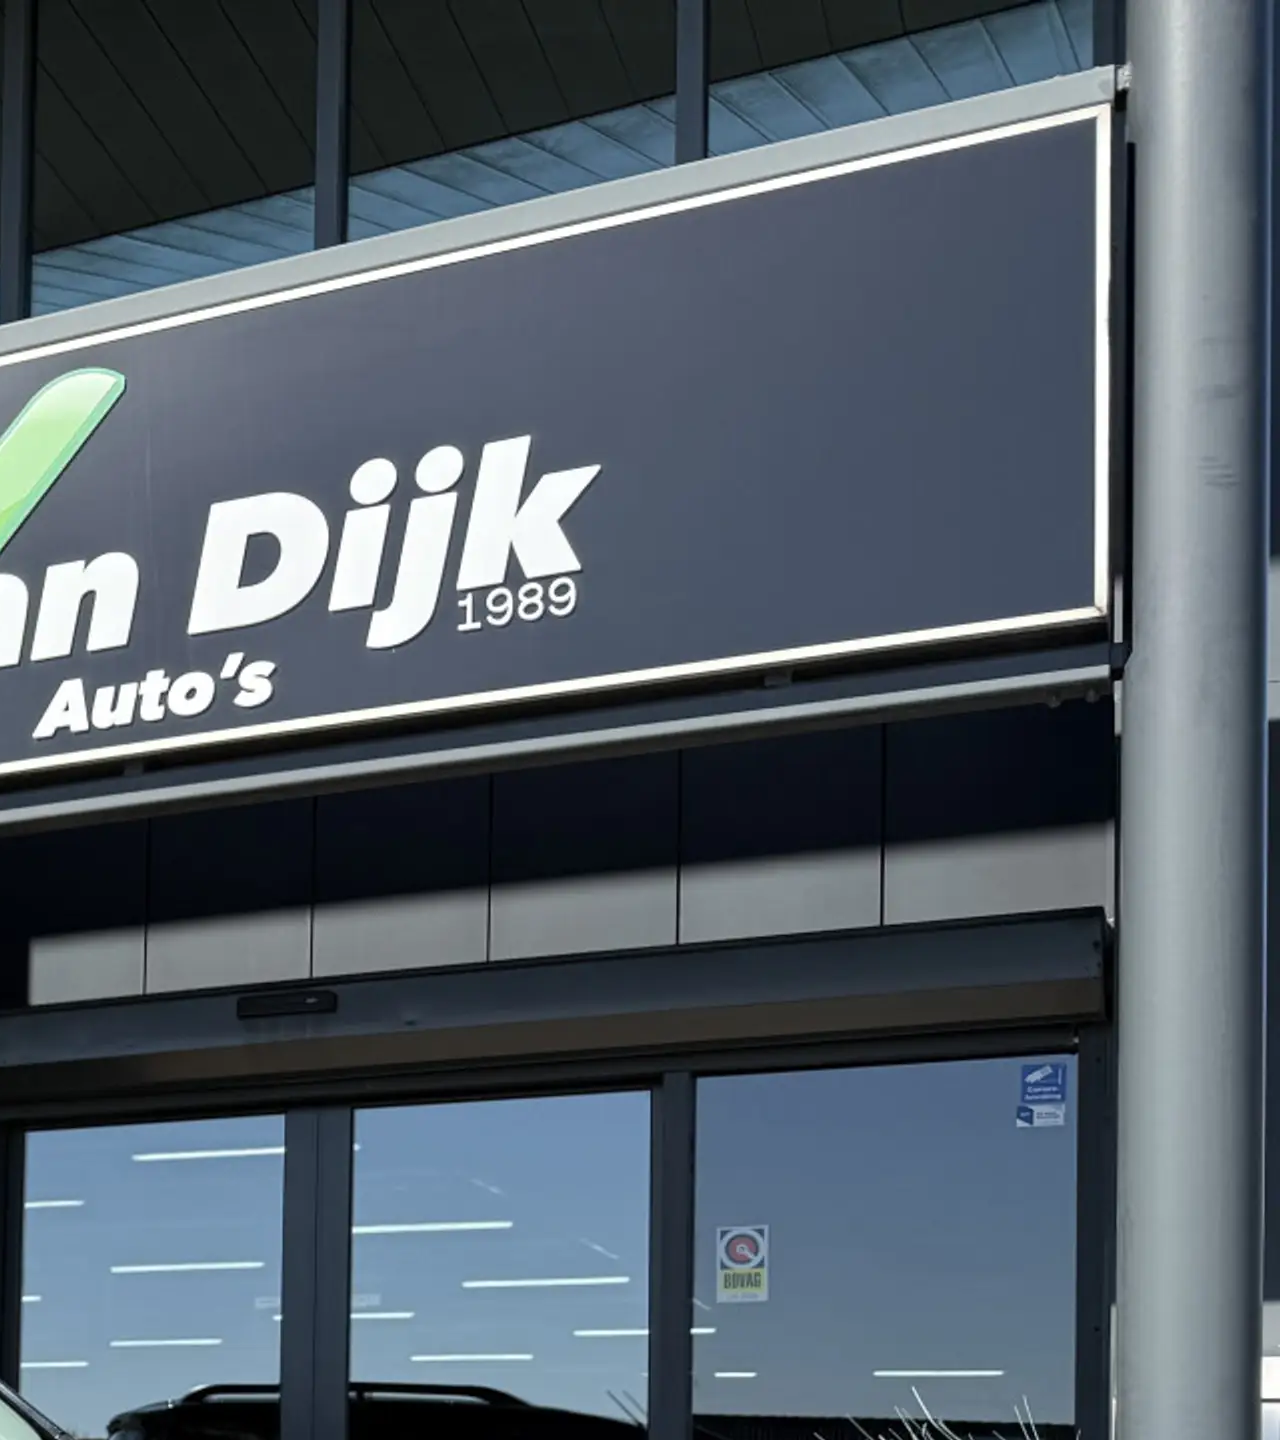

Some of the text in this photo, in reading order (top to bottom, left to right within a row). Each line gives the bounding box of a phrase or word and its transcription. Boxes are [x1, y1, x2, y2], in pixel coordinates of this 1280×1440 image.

[187, 434, 601, 649] Dijk
[454, 575, 578, 633] 1989
[31, 651, 276, 740] Auto's
[724, 1271, 762, 1290] BOVAG
